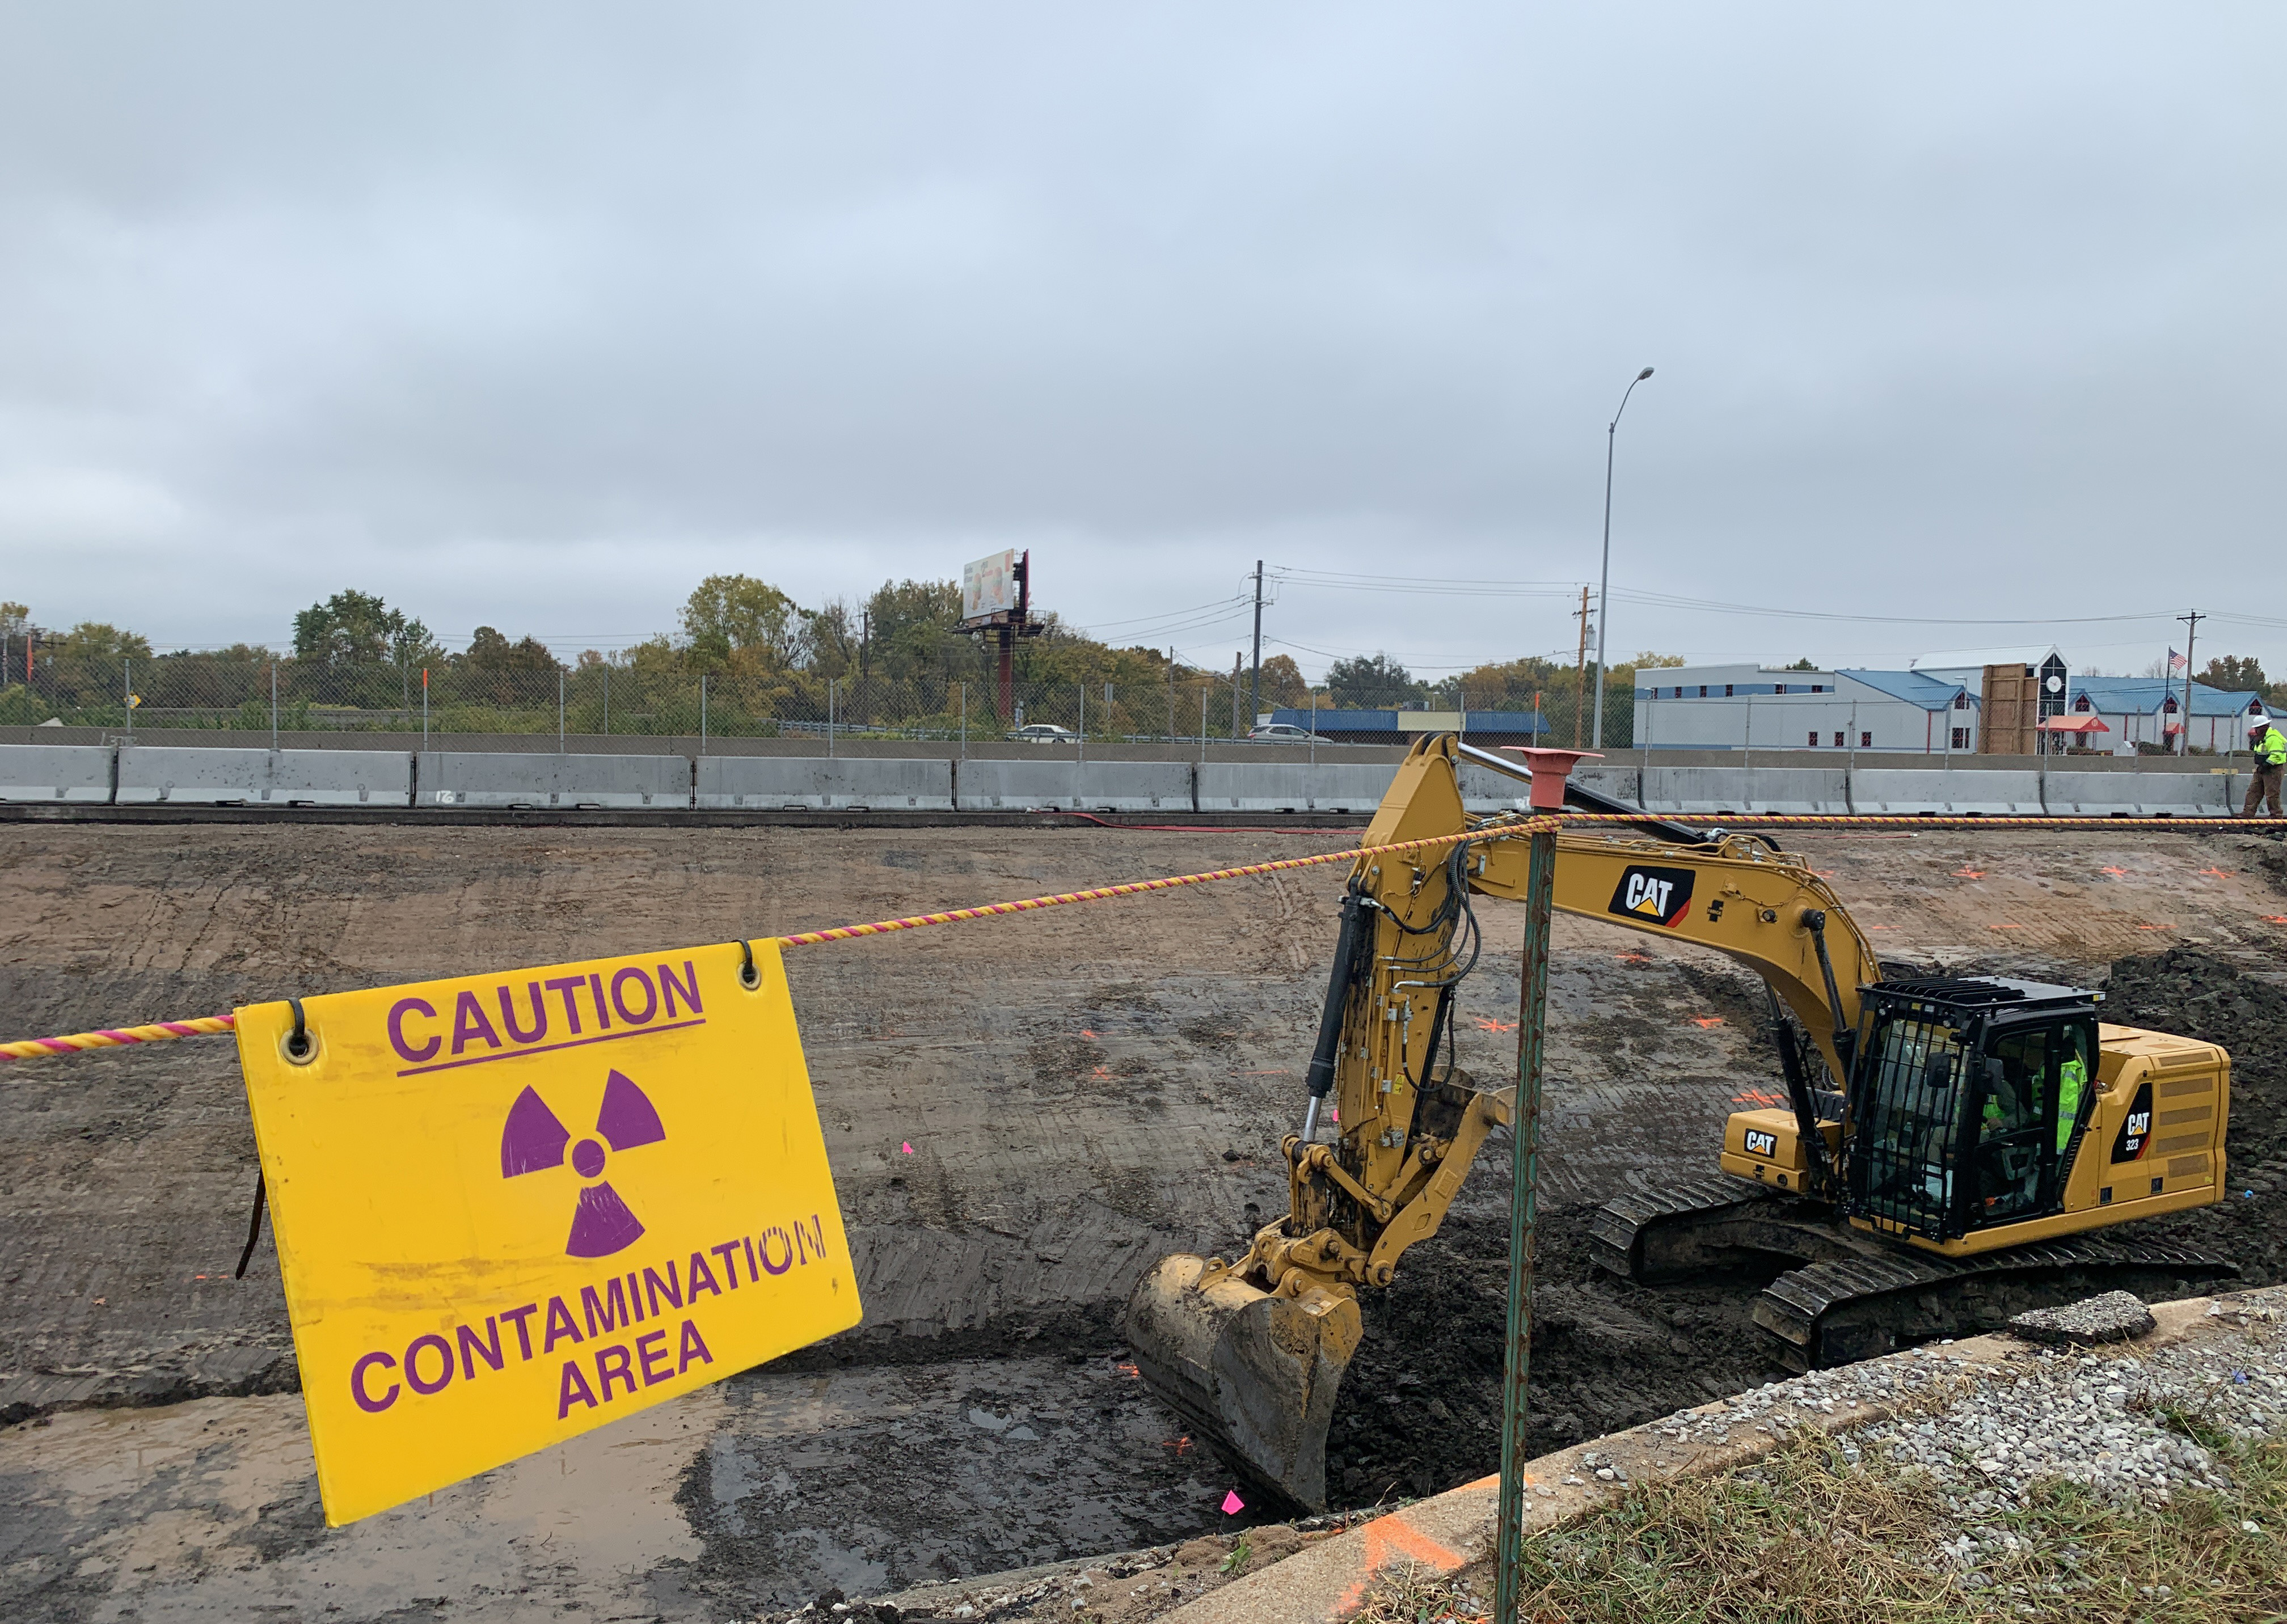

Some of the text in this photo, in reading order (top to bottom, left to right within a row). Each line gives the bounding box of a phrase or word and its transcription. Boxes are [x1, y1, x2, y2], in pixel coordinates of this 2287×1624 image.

[1626, 873, 1673, 917] CAT
[387, 961, 703, 1063] CAUTION
[1746, 1131, 1774, 1156] CAT
[2126, 1138, 2139, 1151] 323
[2128, 1113, 2150, 1136] CAT
[351, 1213, 826, 1414] CONTAMINATION
[557, 1318, 713, 1420] AREA
